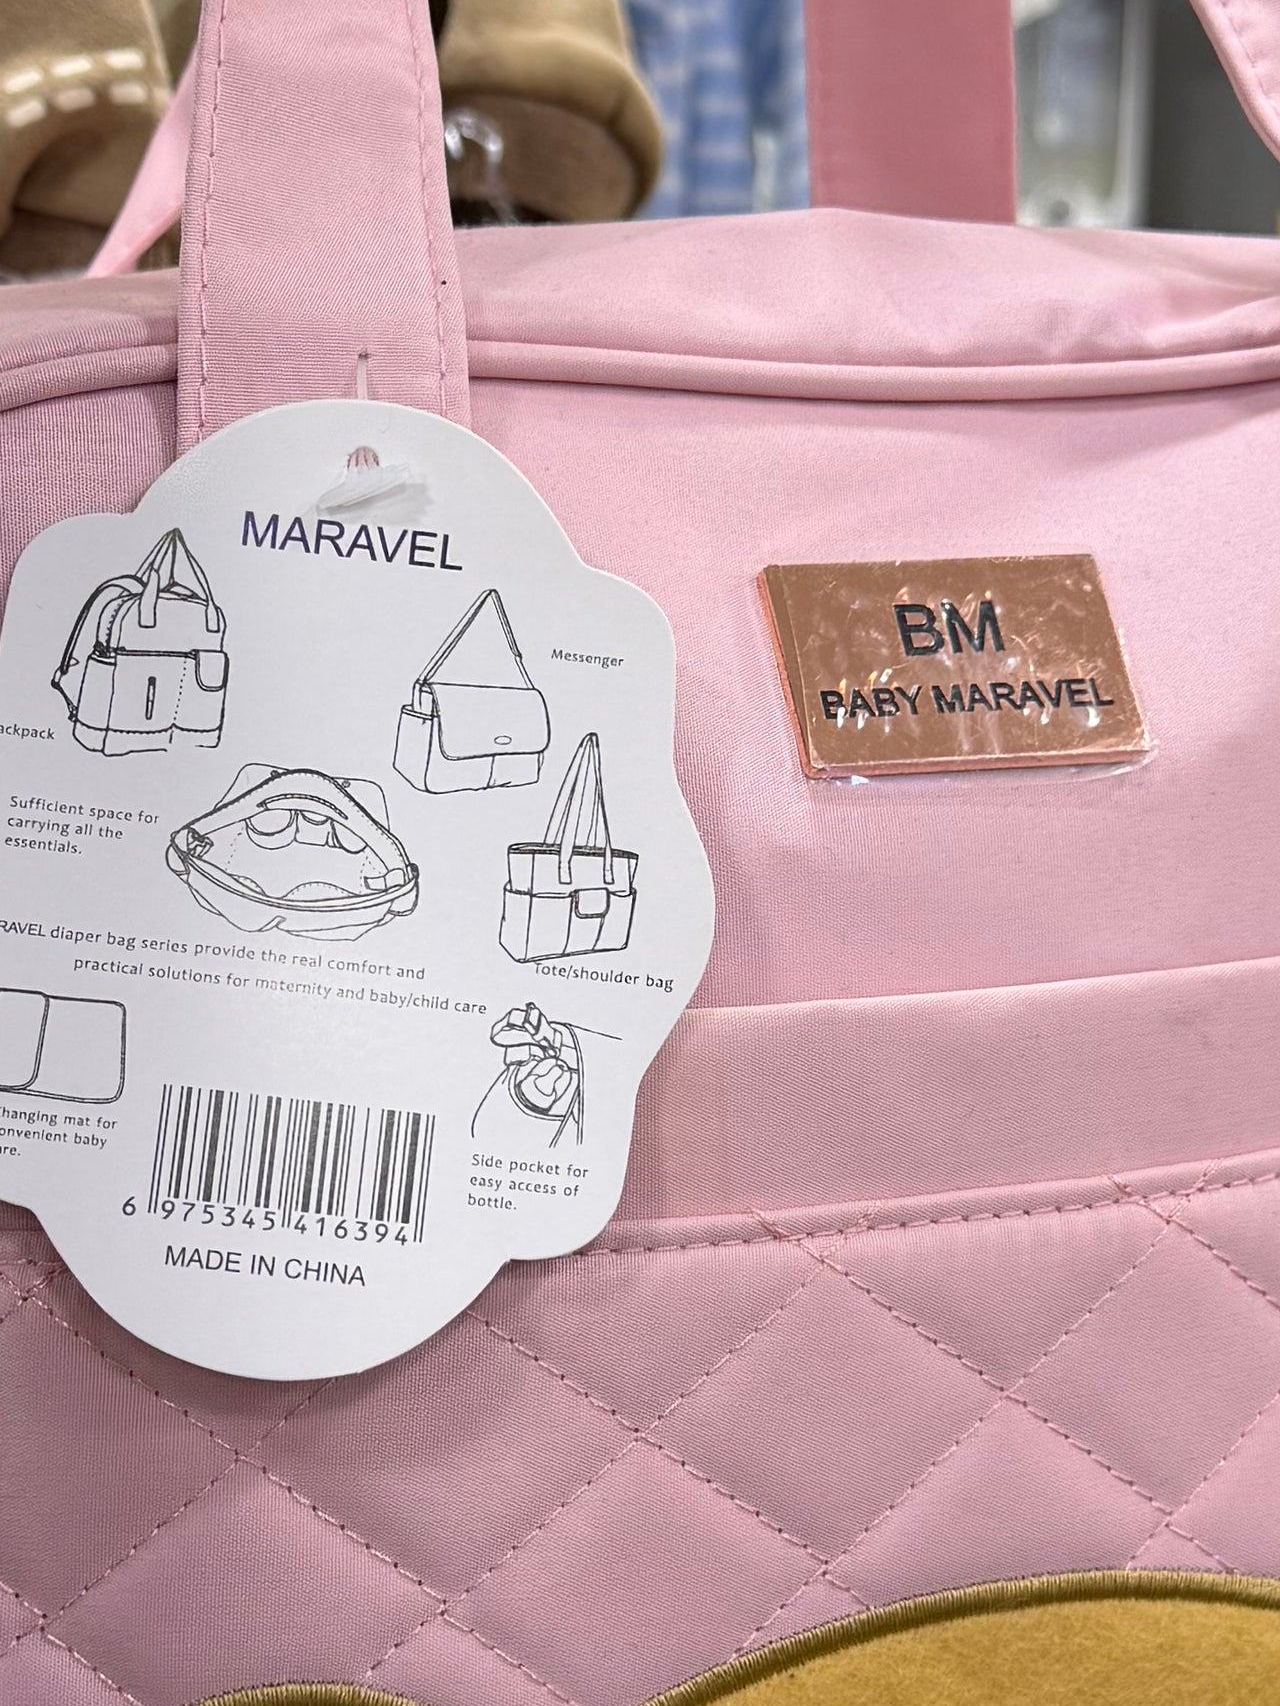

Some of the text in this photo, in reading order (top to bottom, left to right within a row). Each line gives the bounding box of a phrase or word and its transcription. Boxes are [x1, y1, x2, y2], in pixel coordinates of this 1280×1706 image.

[241, 510, 463, 572] MARAVEL
[893, 600, 1006, 657] BM
[550, 648, 625, 670] Messenger
[820, 677, 1115, 721] BABY MARAVEL
[9, 795, 160, 824] Sufficient space for
[7, 816, 123, 840] carrying all the
[4, 836, 82, 855] essentials.
[50, 925, 102, 944] diaper
[106, 931, 136, 952] bag
[140, 937, 188, 954] series
[194, 941, 256, 961] provide
[261, 949, 287, 965] the
[292, 954, 322, 968] real
[327, 958, 391, 976] comfort
[396, 967, 426, 980] and
[73, 958, 487, 1015] practical solutions for maternity and baby/child care
[534, 962, 675, 994] Tote/shoulder bag
[63, 1115, 91, 1127] mat
[96, 1116, 118, 1130] for
[73, 1132, 108, 1150] baby
[471, 1153, 589, 1178] Side pocket for
[469, 1175, 580, 1197] easy access of
[467, 1192, 517, 1210] bottle.
[164, 1244, 366, 1288] MADE IN CHINA
